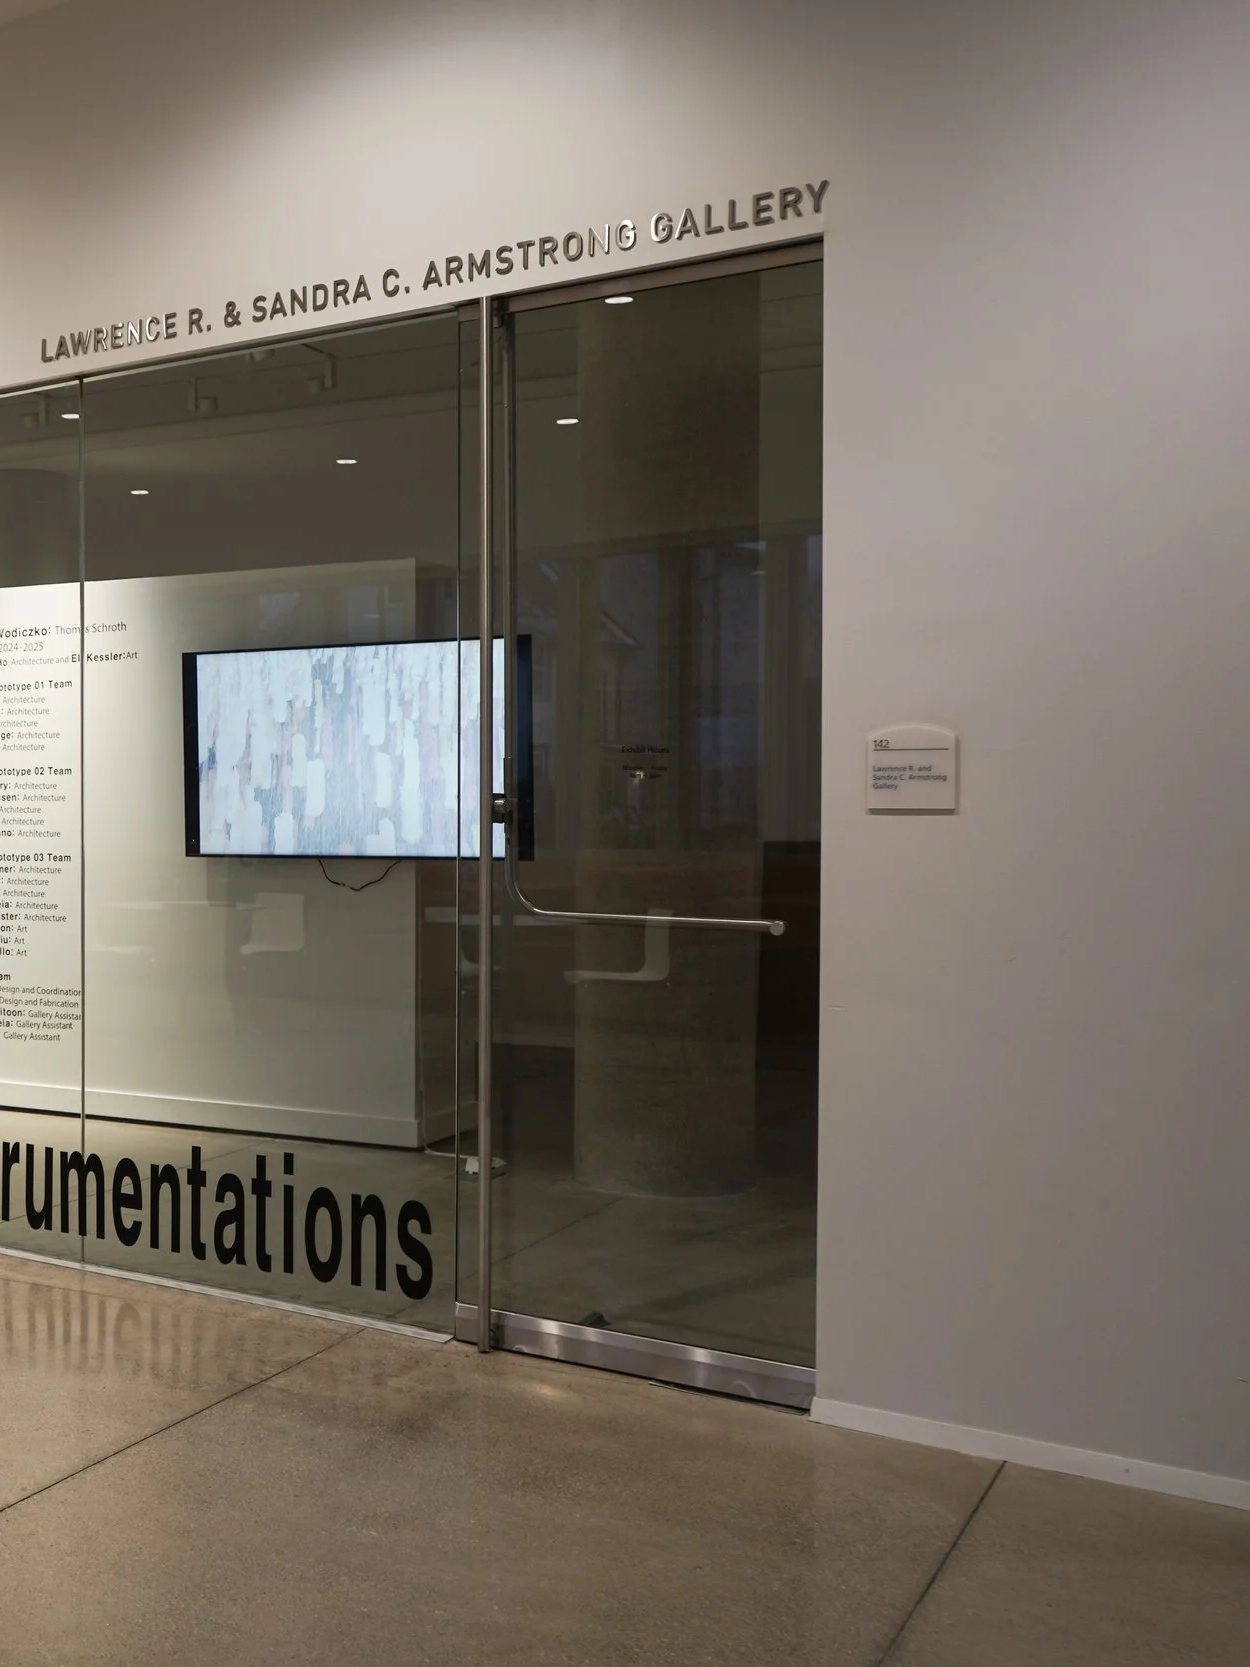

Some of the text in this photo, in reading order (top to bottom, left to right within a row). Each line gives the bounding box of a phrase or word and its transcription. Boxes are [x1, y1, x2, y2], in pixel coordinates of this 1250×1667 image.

[41, 313, 177, 363] LAWRENCE
[188, 308, 212, 335] R.
[223, 300, 242, 328] &
[251, 275, 371, 323] SANDRA
[422, 219, 636, 291] ARMSTRONG
[650, 179, 830, 243] GALLERY
[55, 625, 90, 636] Thoms
[91, 622, 127, 633] Schroth
[11, 656, 54, 666] Architecture
[55, 656, 69, 664] and
[34, 682, 44, 690] 01
[49, 680, 73, 688] Team
[7, 707, 50, 715] Architecture
[16, 731, 60, 739] Architecture
[2, 743, 45, 751] Architecture
[873, 739, 890, 749] 142
[34, 767, 44, 775] 02
[48, 767, 72, 775] Team
[908, 774, 947, 782] Armstrong
[14, 782, 57, 790] Architecture
[872, 782, 898, 791] Gallery
[23, 794, 66, 802] Architecture
[0, 806, 41, 814] Architecture
[1, 818, 44, 826] Architecture
[18, 830, 61, 838] Architecture
[47, 854, 72, 862] Team
[6, 878, 49, 886] Architecture
[2, 890, 45, 898] Architecture
[15, 902, 58, 910] Architecture
[24, 914, 67, 922] Architecture
[17, 925, 28, 933] Art
[14, 937, 25, 945] Art
[16, 949, 27, 957] Art
[22, 986, 35, 994] and
[0, 996, 23, 1006] Design
[24, 998, 38, 1006] and
[40, 999, 79, 1008] Fabrication
[28, 1009, 52, 1020] Gallery
[16, 1019, 39, 1030] Gallery
[42, 1021, 73, 1030] Assistant
[3, 1031, 28, 1042] Gallery
[29, 1032, 60, 1041] Assistant
